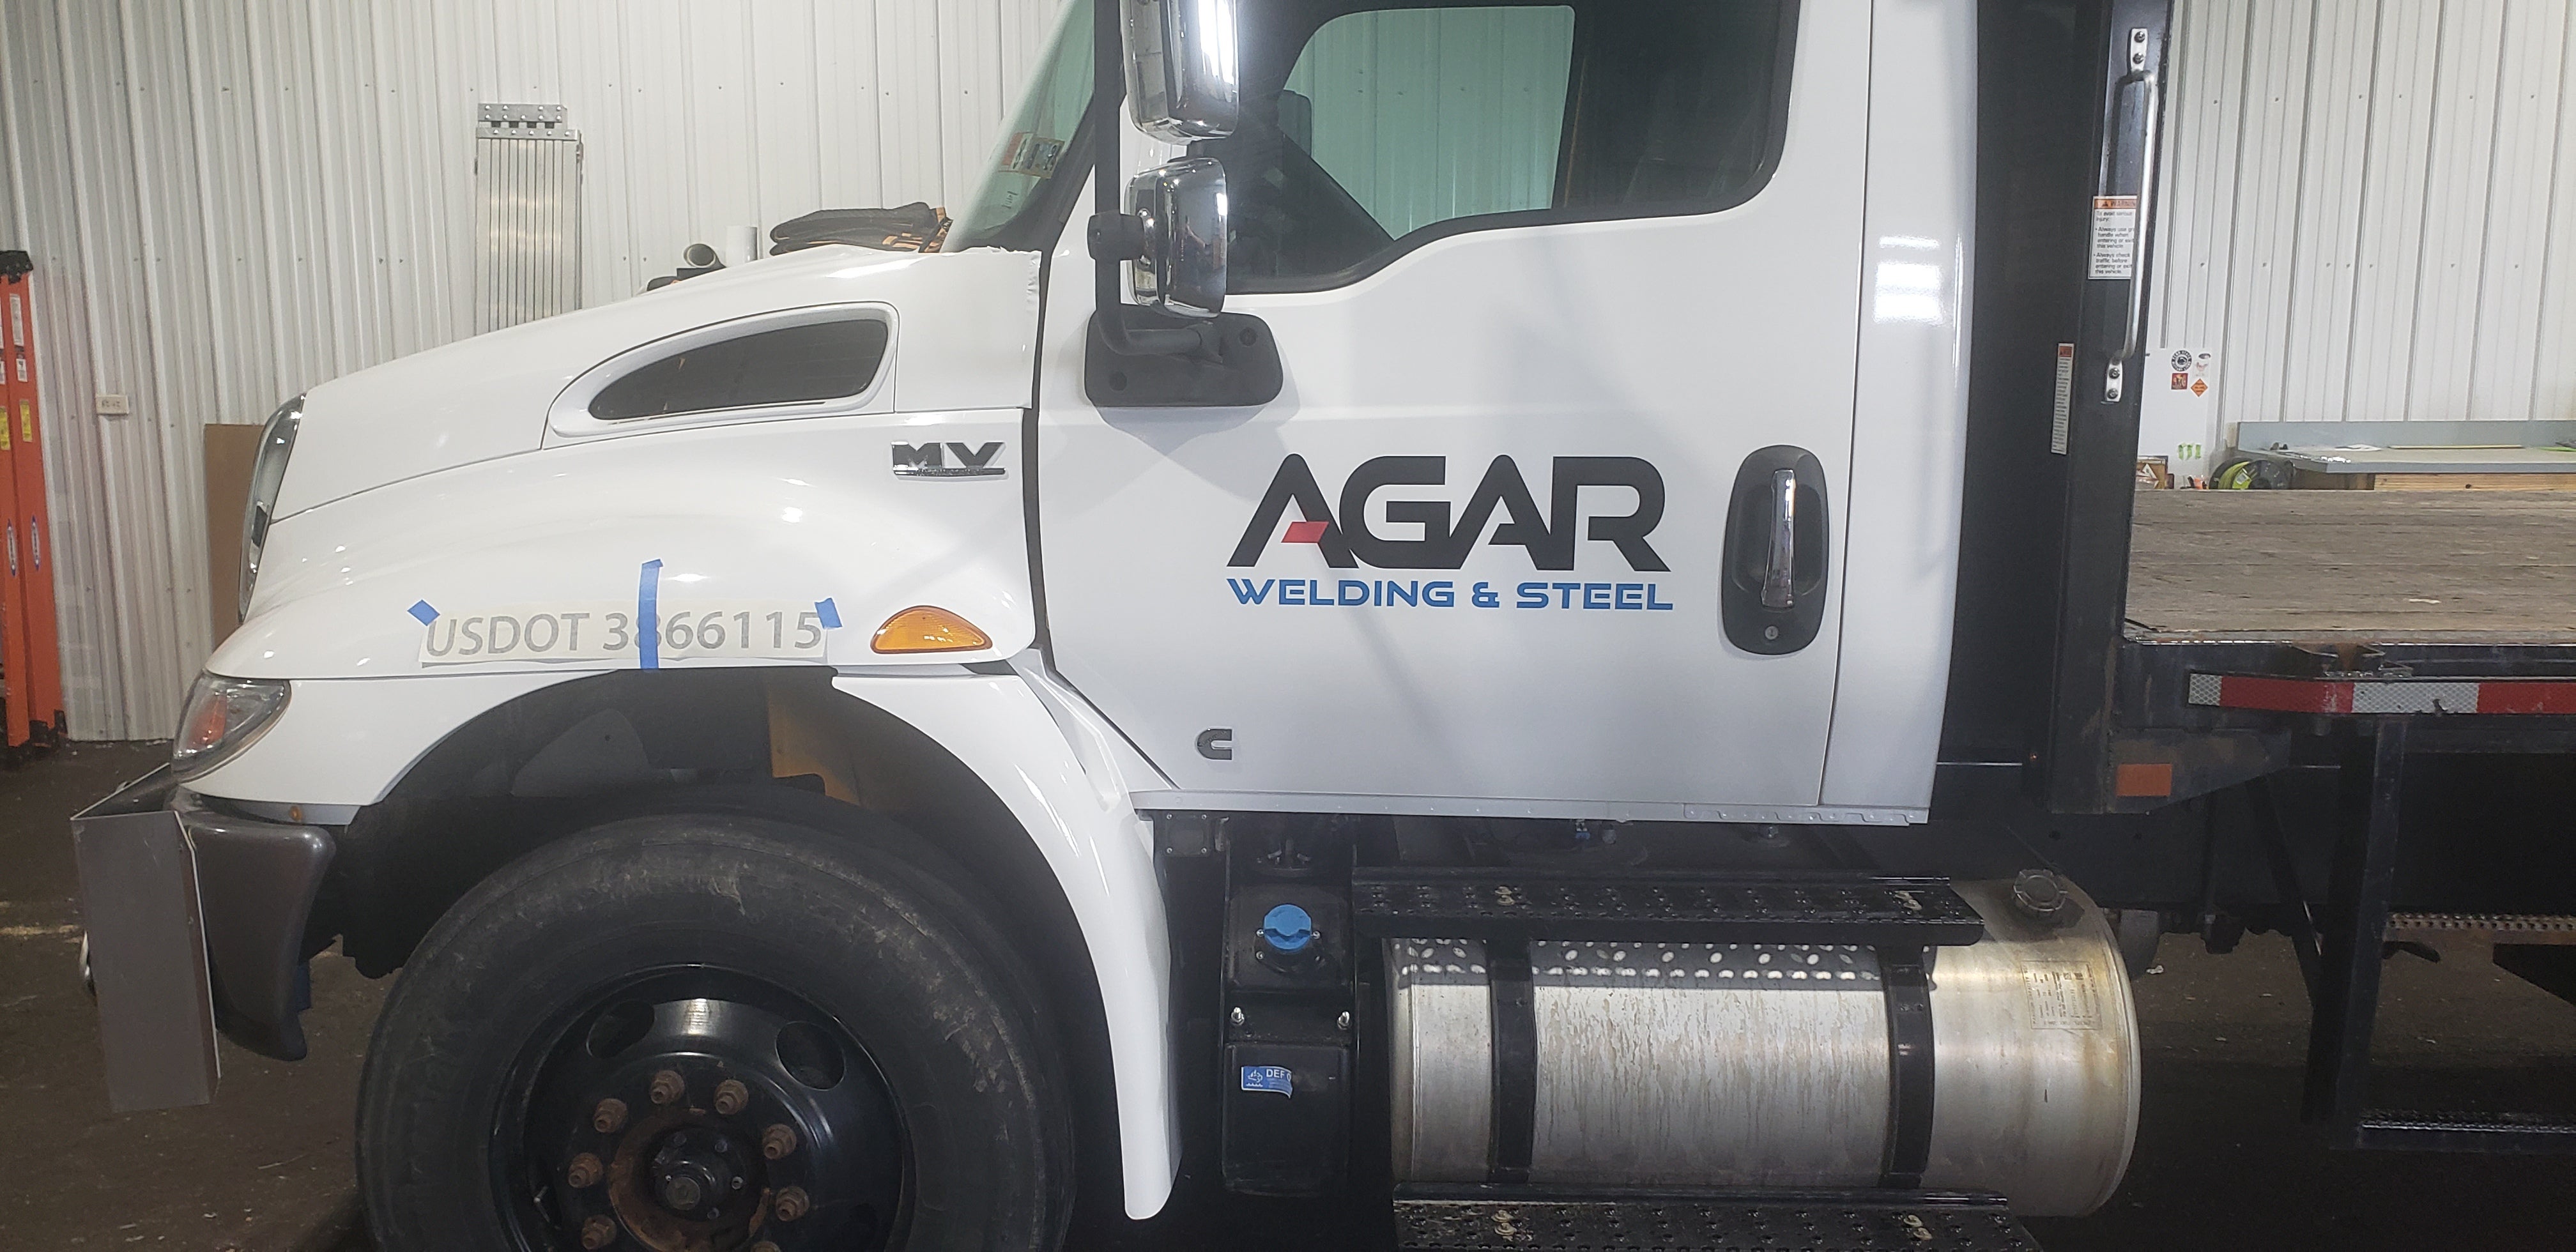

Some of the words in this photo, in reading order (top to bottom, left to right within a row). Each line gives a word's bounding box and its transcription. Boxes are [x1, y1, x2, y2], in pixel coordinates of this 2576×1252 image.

[1227, 454, 1671, 572] AGAR
[1227, 579, 1455, 608] WELDING
[1471, 582, 1500, 608] &
[1517, 583, 1673, 611] STEEL
[425, 612, 590, 657] USDOT
[603, 610, 822, 651] 366115
[1266, 1069, 1285, 1079] DEF
